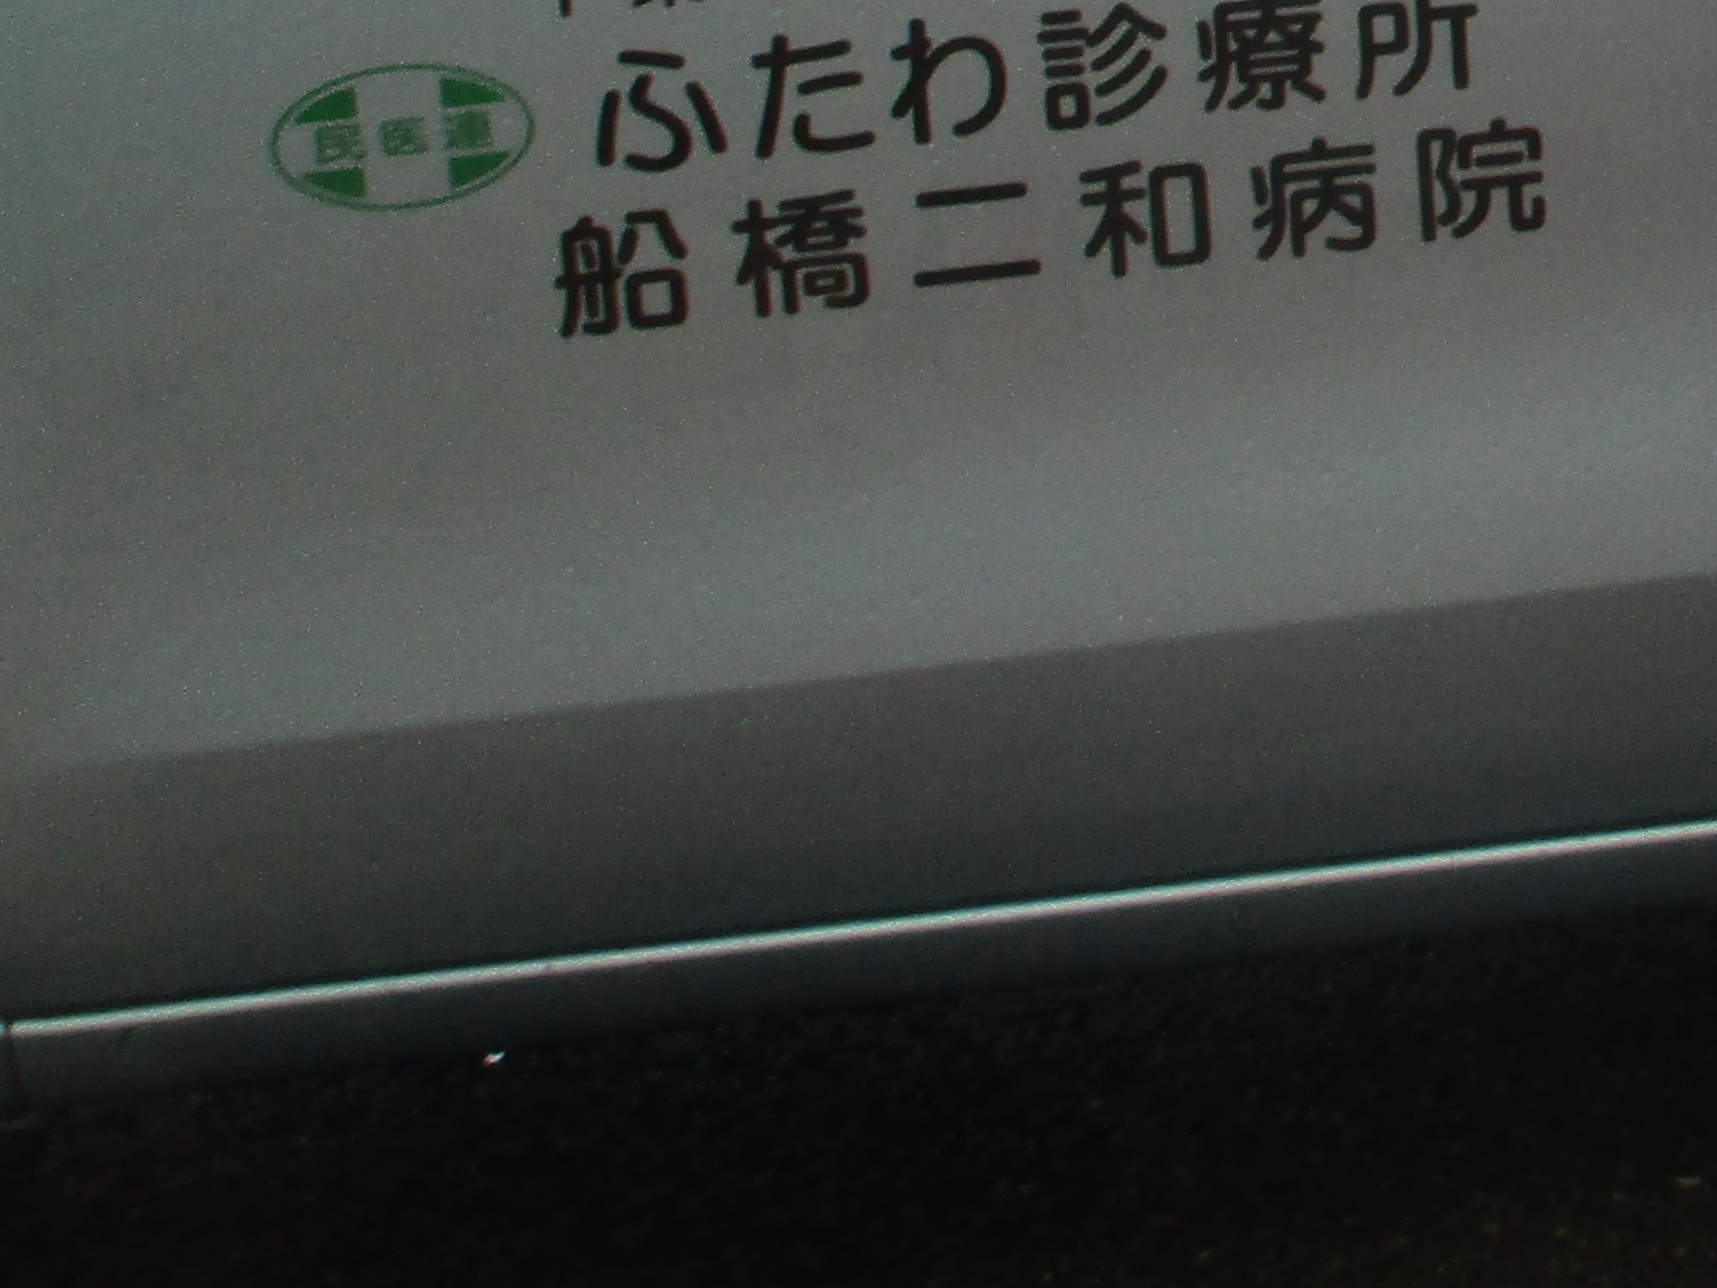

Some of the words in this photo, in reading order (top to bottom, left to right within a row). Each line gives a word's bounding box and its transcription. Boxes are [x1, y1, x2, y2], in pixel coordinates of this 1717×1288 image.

[552, 116, 1548, 341] 船橋二和病院
